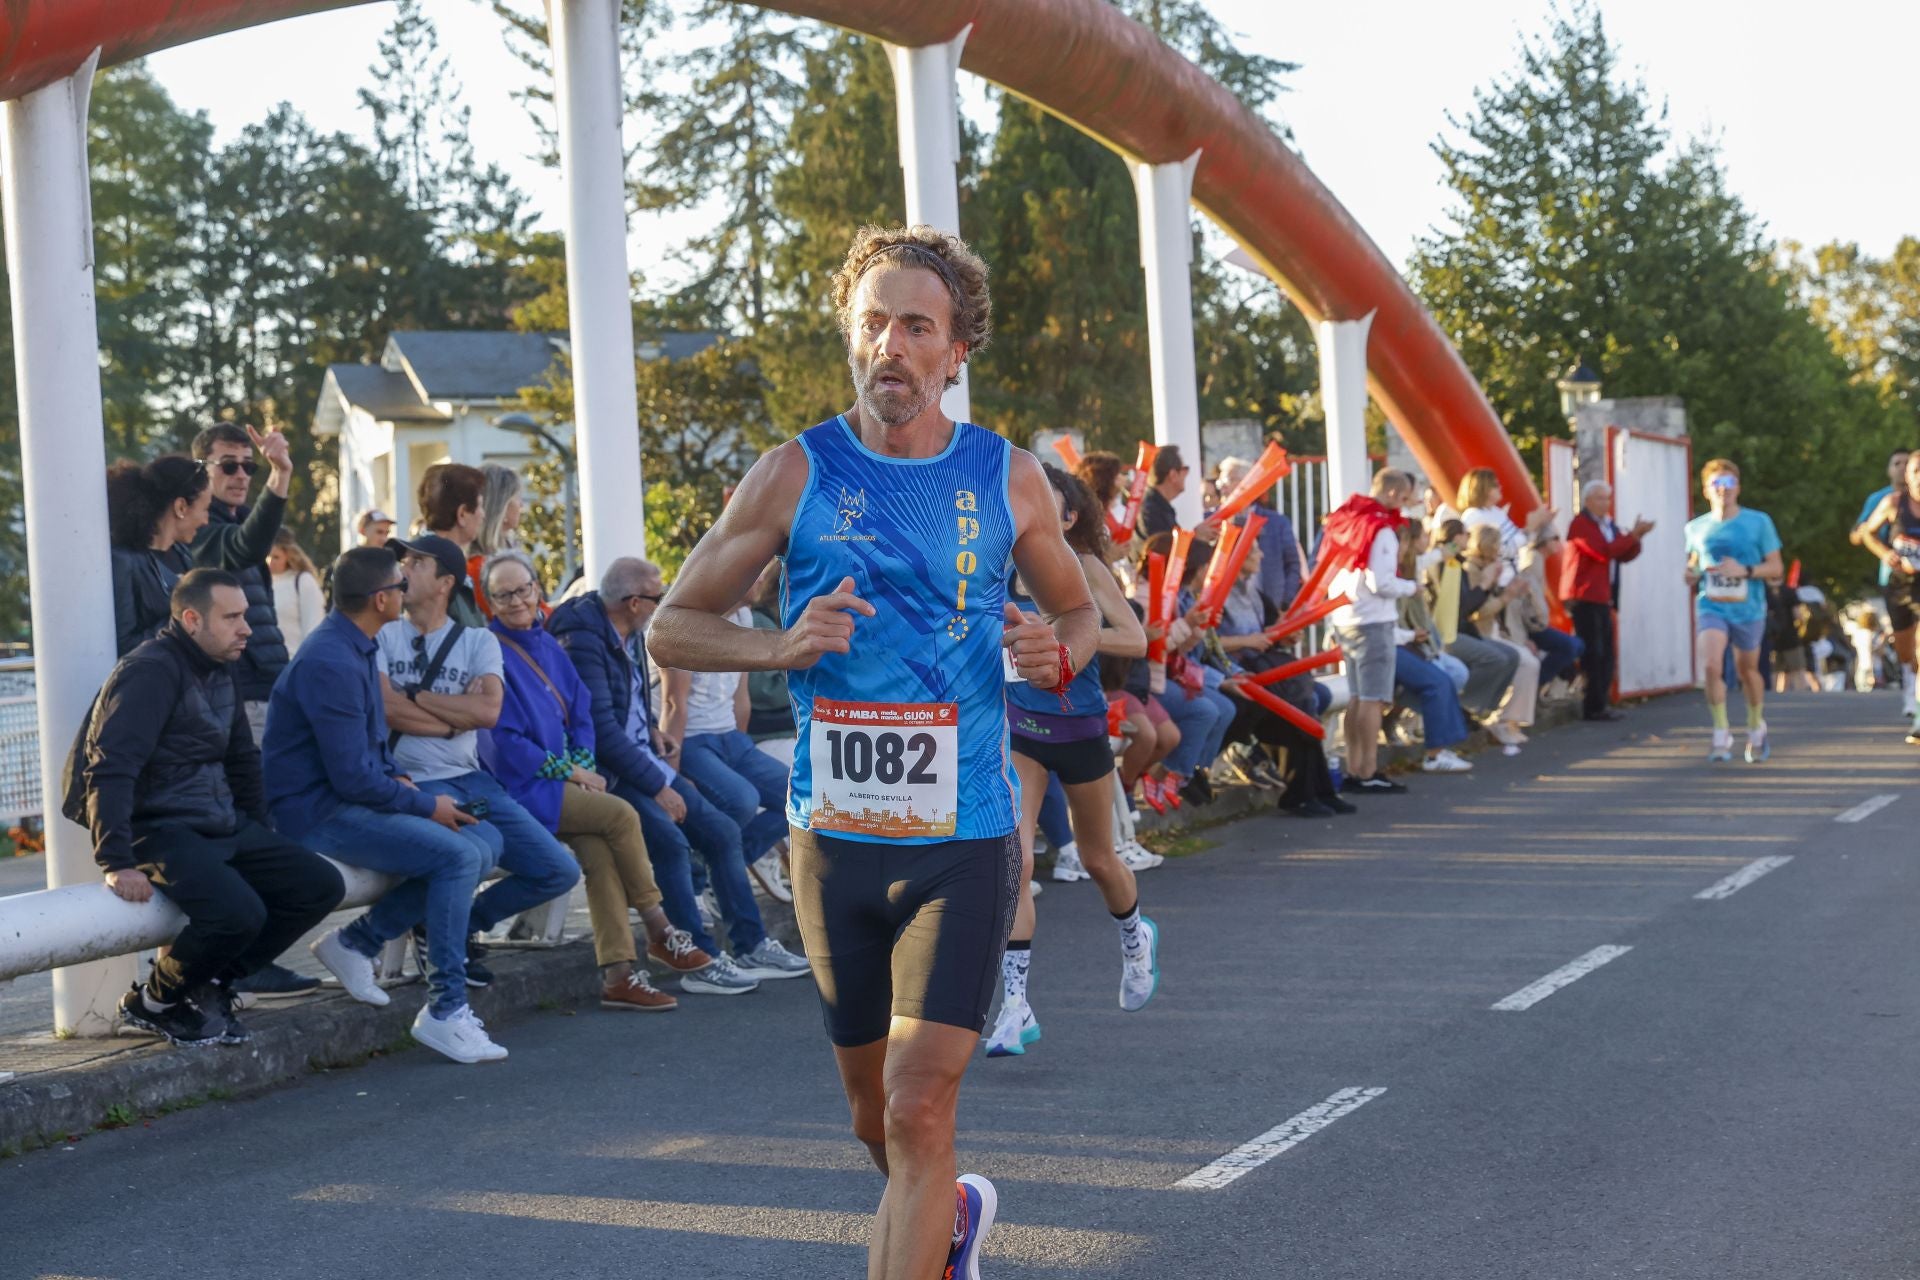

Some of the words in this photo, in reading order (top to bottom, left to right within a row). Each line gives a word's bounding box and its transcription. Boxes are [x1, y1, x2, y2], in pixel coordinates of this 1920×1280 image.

[849, 710, 879, 720] MBA
[903, 709, 934, 721] GIJÓN
[826, 730, 937, 784] 1082
[849, 792, 880, 800] ALBERTO
